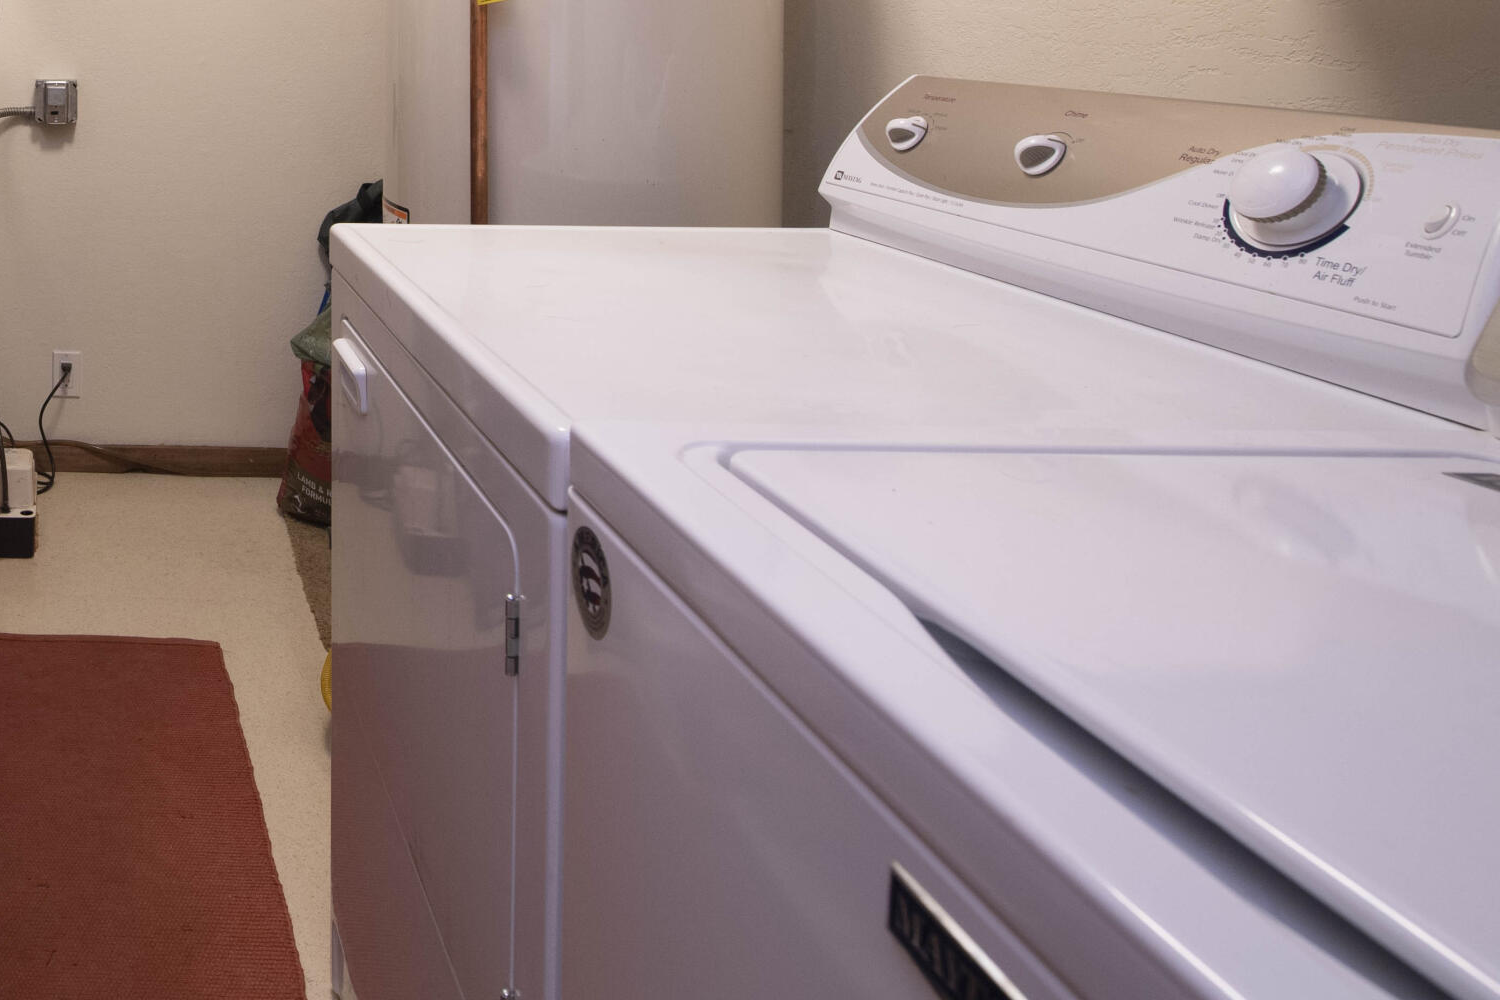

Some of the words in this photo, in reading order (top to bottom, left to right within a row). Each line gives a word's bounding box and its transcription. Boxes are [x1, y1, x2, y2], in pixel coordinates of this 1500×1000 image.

[1187, 145, 1206, 154] Auto
[1206, 147, 1220, 157] Dry
[1179, 153, 1215, 165] Regular
[1315, 256, 1340, 271] Time
[1312, 270, 1329, 281] Air
[1329, 273, 1357, 288] Fluff
[297, 472, 316, 490] LAMB
